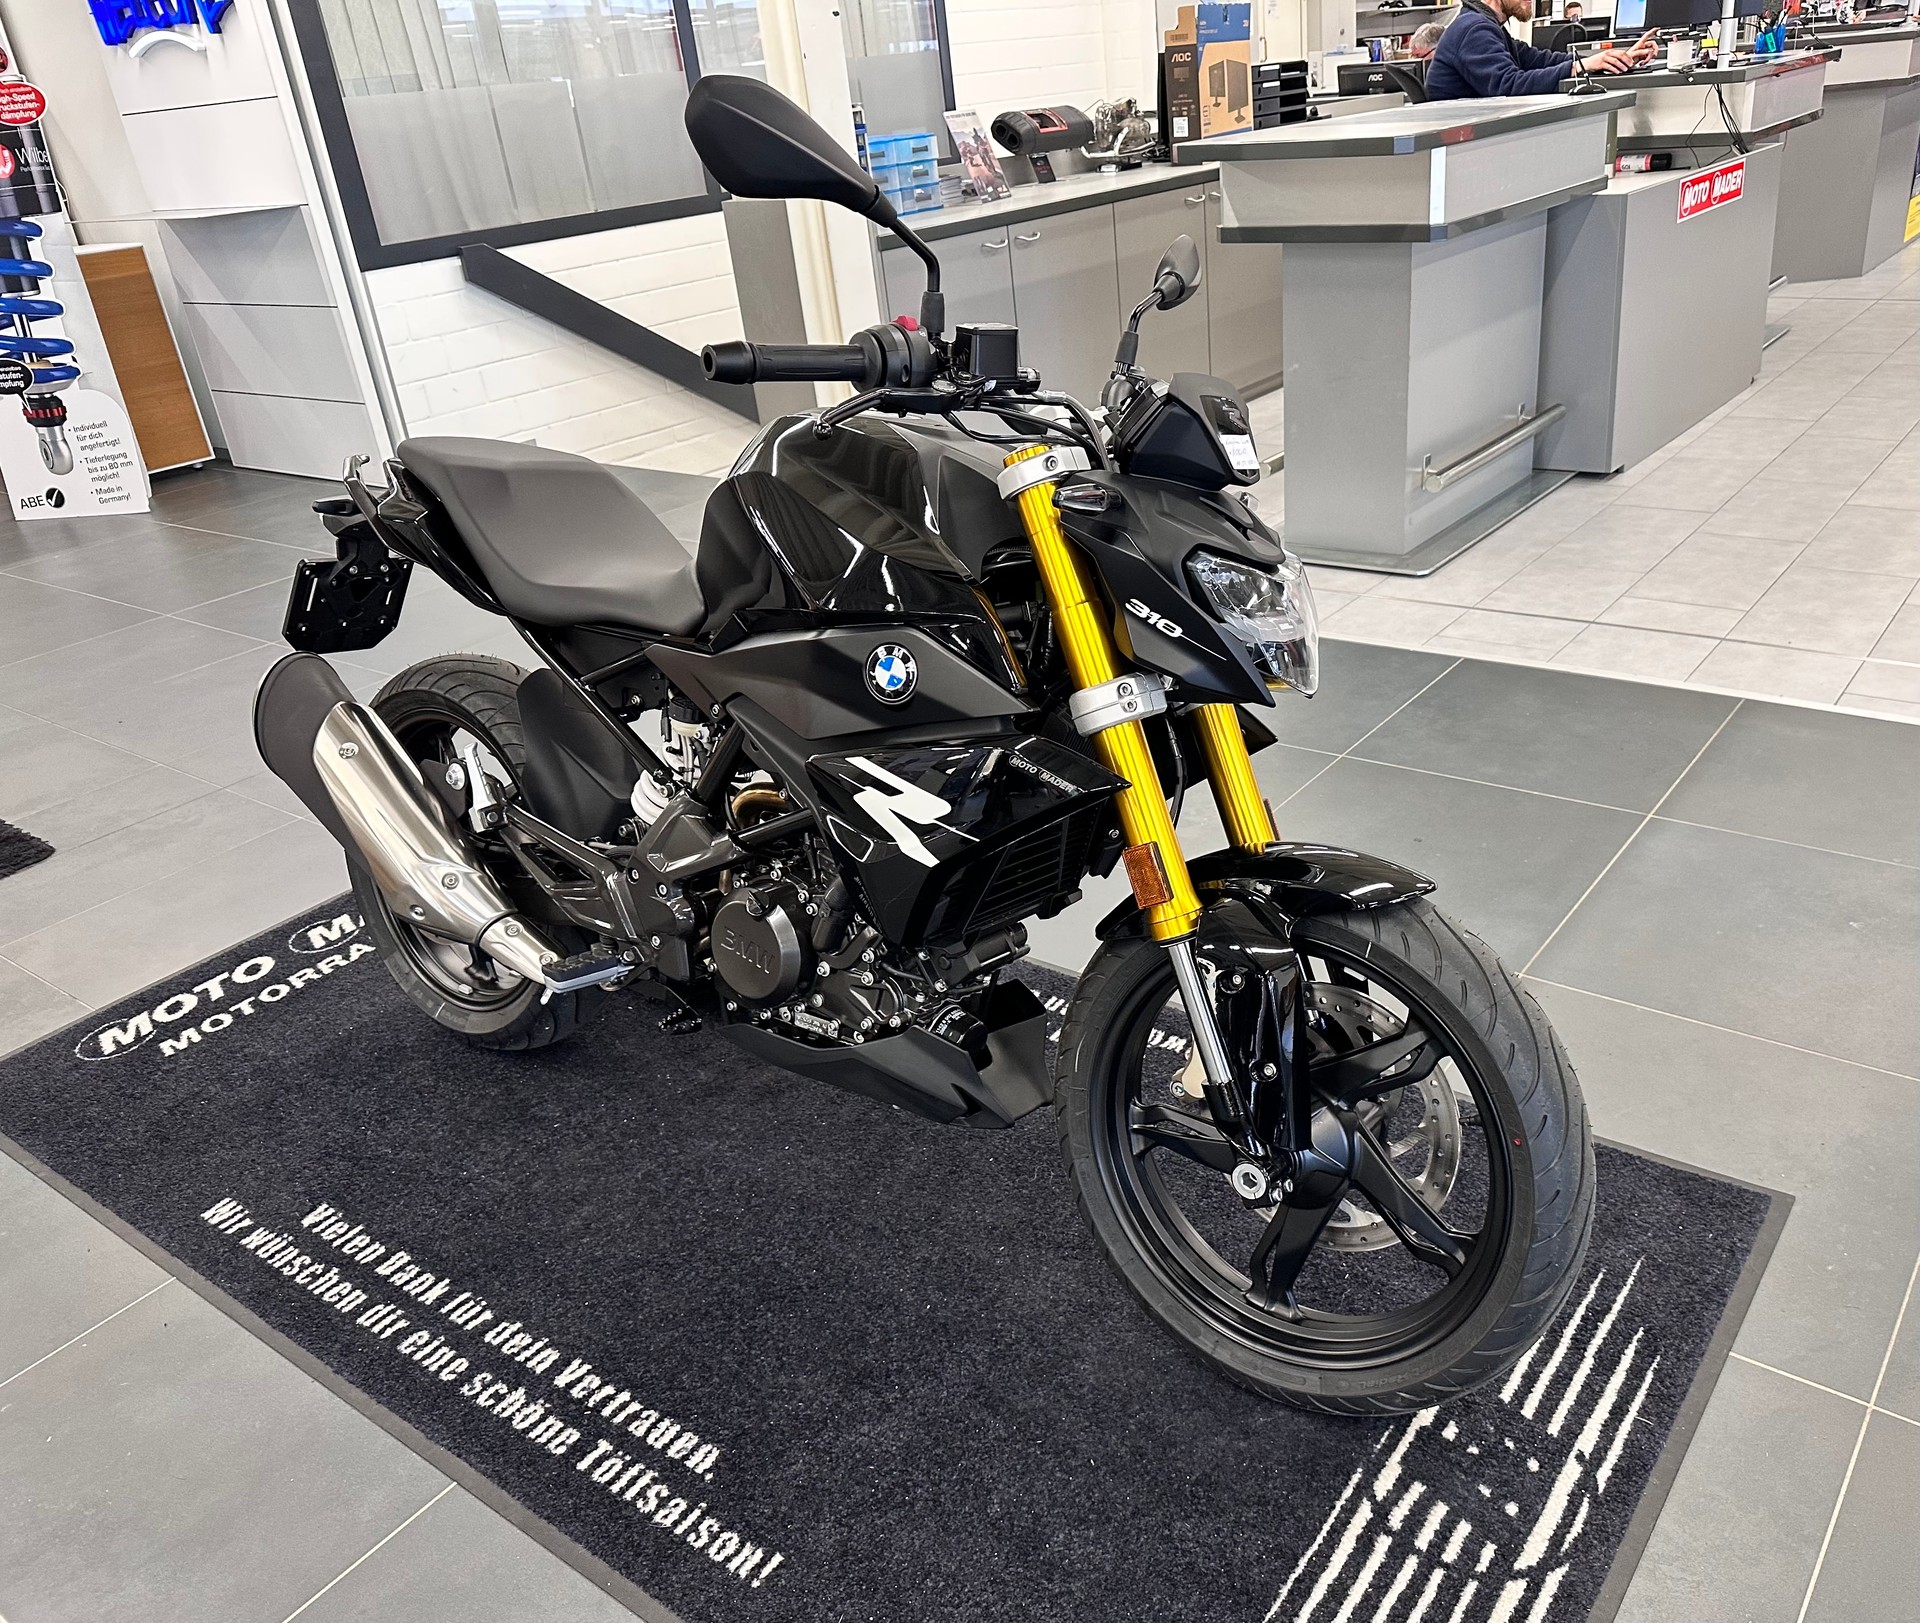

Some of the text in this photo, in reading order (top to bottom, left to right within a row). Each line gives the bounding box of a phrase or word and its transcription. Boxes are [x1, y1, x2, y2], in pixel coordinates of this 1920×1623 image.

[1171, 52, 1192, 62] AOC
[1368, 73, 1384, 82] AOC
[0, 92, 36, 105] gh-Speed
[1, 110, 37, 120] dämpfung
[1682, 169, 1743, 212] MOTO MADER
[73, 420, 108, 433] Individuell
[76, 431, 104, 442] für dich
[80, 437, 121, 451] angefertigt!
[84, 452, 128, 464] Tieferlegung
[87, 460, 134, 474] bis zu 80 mm
[91, 471, 120, 482] möglich!
[95, 484, 123, 496] Made in
[20, 495, 46, 509] ABE
[98, 492, 132, 505] Germany!
[1124, 598, 1184, 638] 310
[876, 645, 917, 673] BMW
[1010, 756, 1077, 793] MOTO MADER
[721, 926, 776, 974] BMW
[92, 955, 276, 1057] MOTO
[158, 942, 377, 1057] MOTORRA
[300, 1202, 720, 1481] Vielen Dank für dein Vertrauen.
[200, 1197, 785, 1588] Wir wünschen dir eine schöne Töffsaison!
